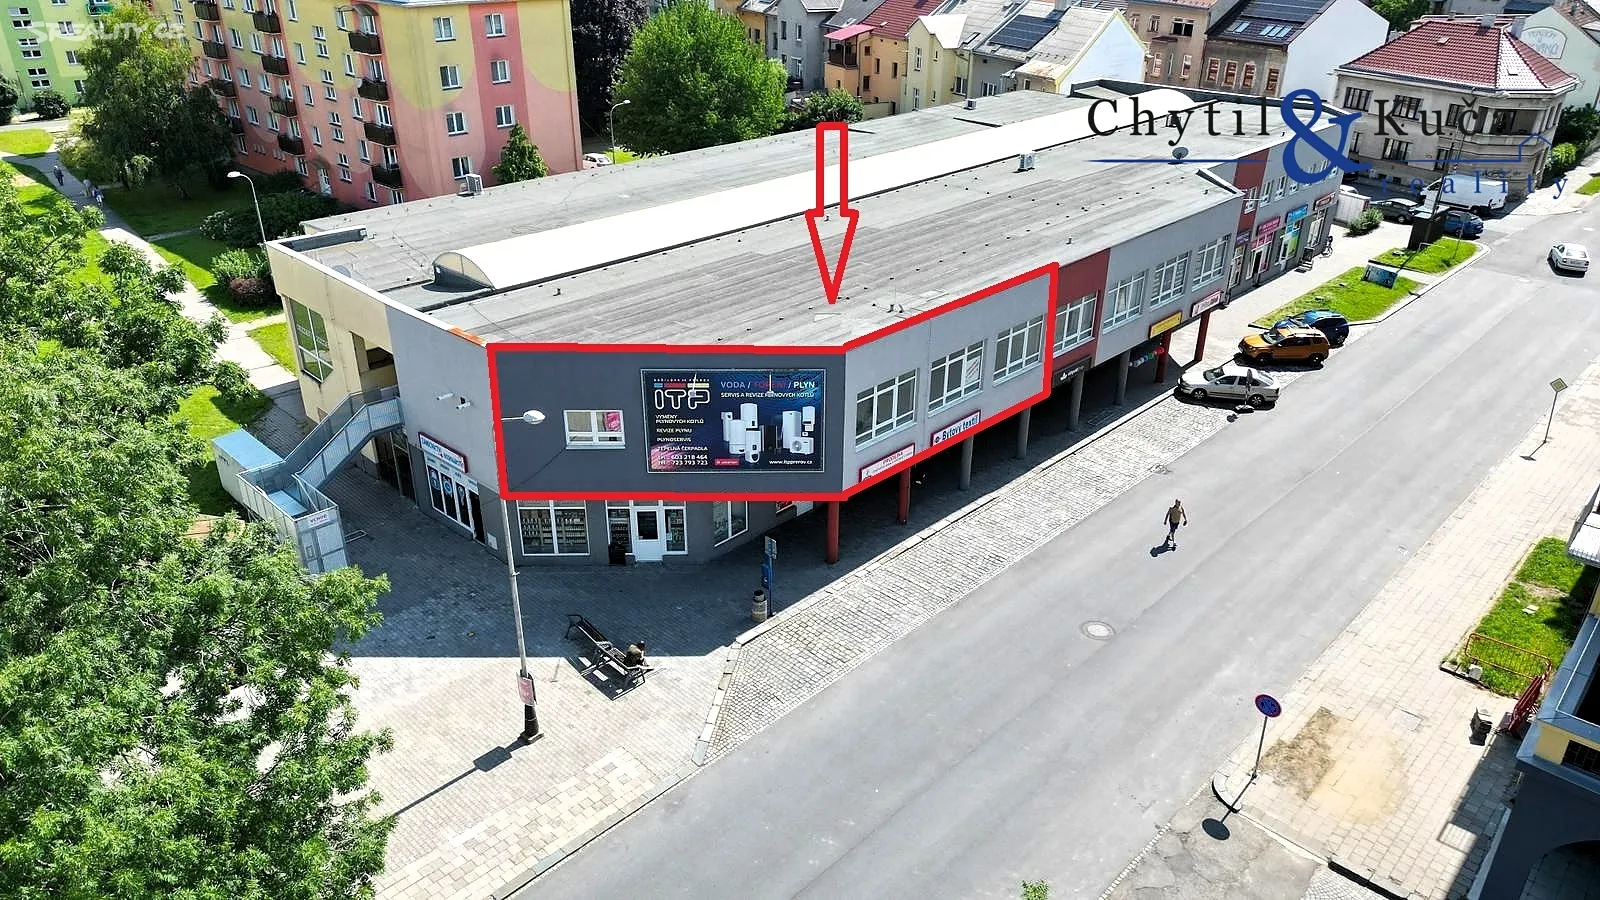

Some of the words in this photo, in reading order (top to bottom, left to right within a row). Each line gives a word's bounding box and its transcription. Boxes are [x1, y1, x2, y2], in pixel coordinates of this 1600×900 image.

[720, 381, 746, 389] VODA
[793, 381, 815, 389] PLYN
[654, 388, 710, 410] ITP
